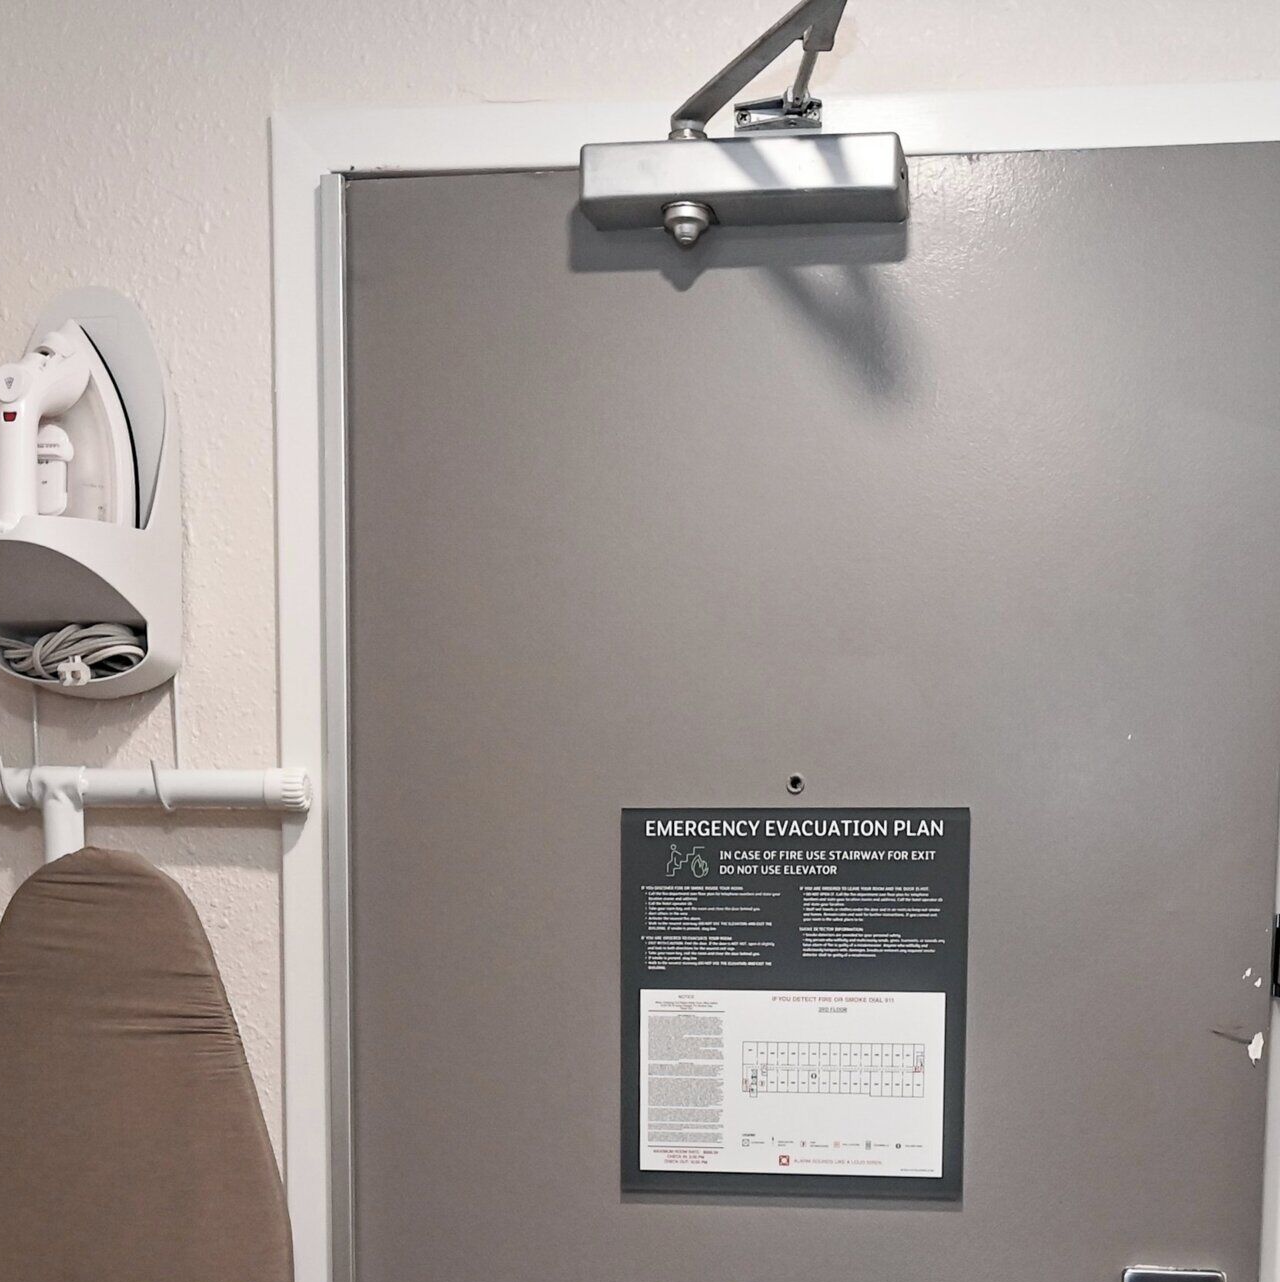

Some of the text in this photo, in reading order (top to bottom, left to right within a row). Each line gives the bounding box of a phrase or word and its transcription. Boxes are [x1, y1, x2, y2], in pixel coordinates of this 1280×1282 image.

[645, 820, 944, 837] EMERGENCY EVACUATION PLAN
[720, 850, 936, 860] IN CASE OF FIRE USE STAIRWAY FOR EXIT
[720, 865, 838, 875] DO NOT USE ELEVATOR
